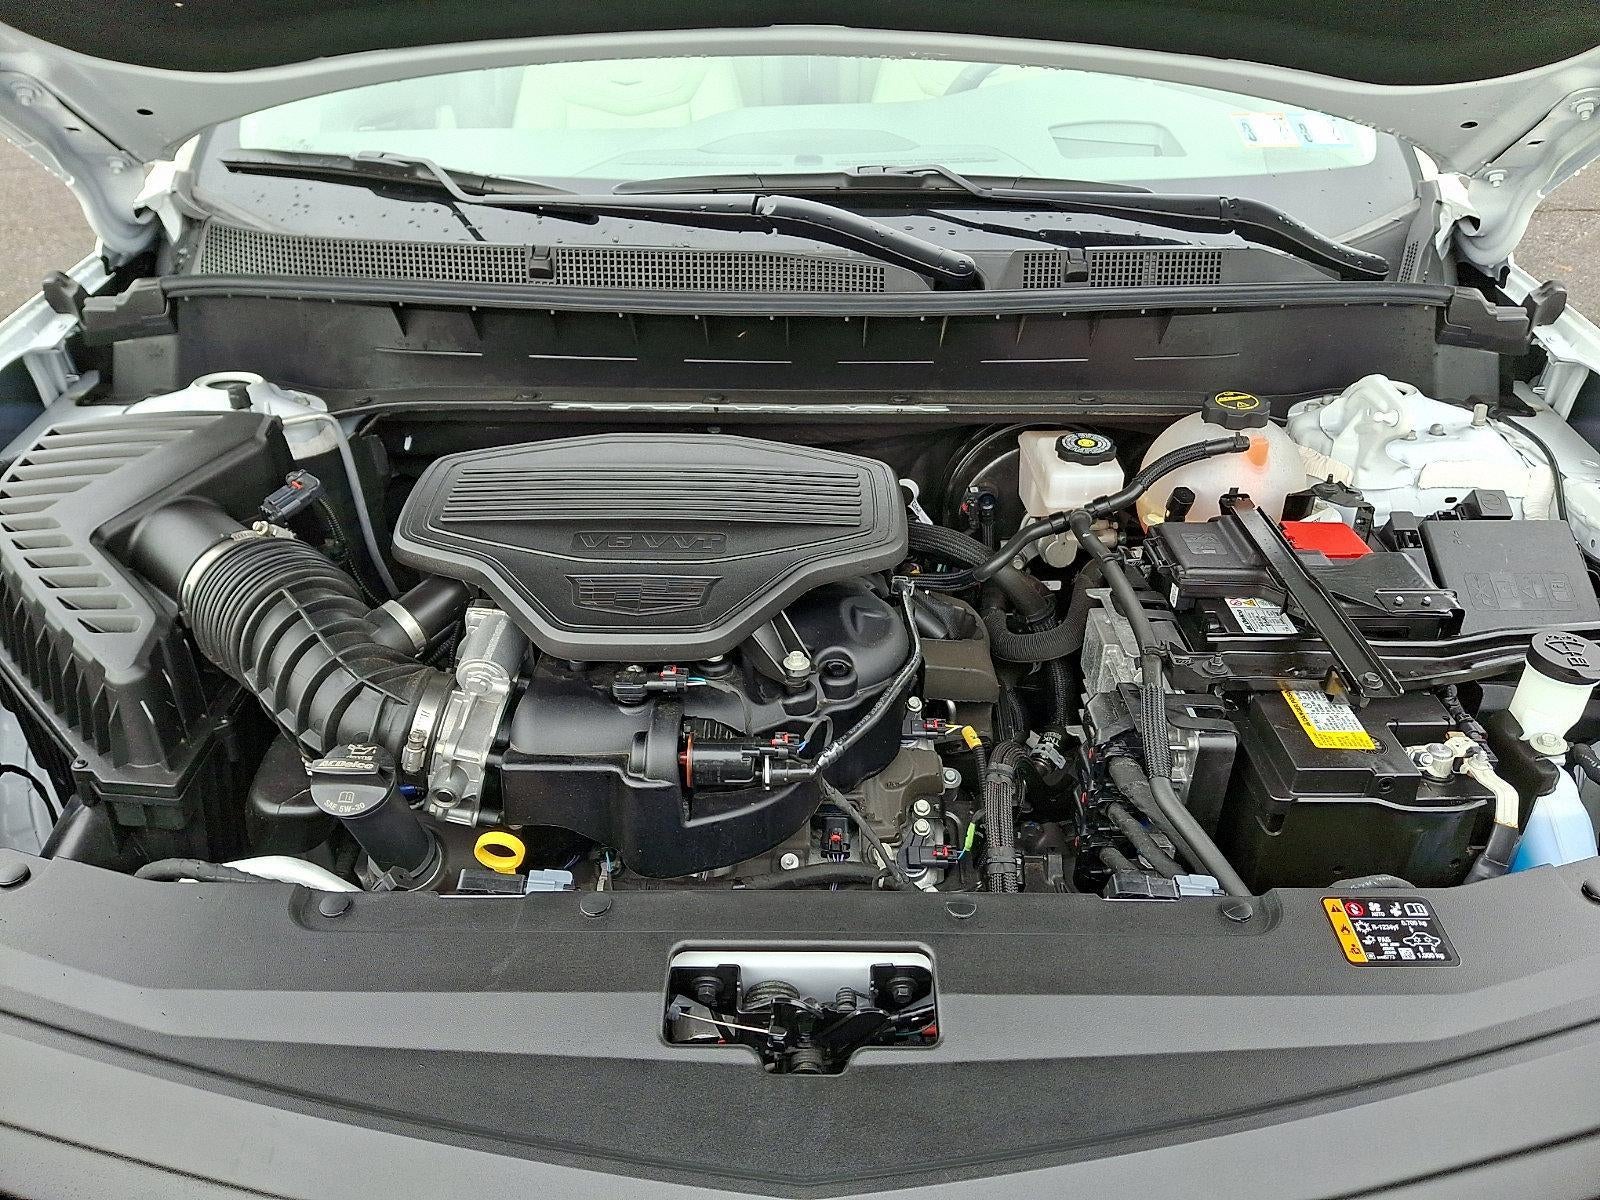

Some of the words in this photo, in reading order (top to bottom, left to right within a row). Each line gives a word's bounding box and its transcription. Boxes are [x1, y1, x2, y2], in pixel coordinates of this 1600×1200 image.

[579, 534, 633, 548] V6
[641, 534, 721, 549] VVT
[318, 760, 374, 769] ACDelco
[323, 799, 338, 811] SAE
[338, 802, 366, 813] 5W-30
